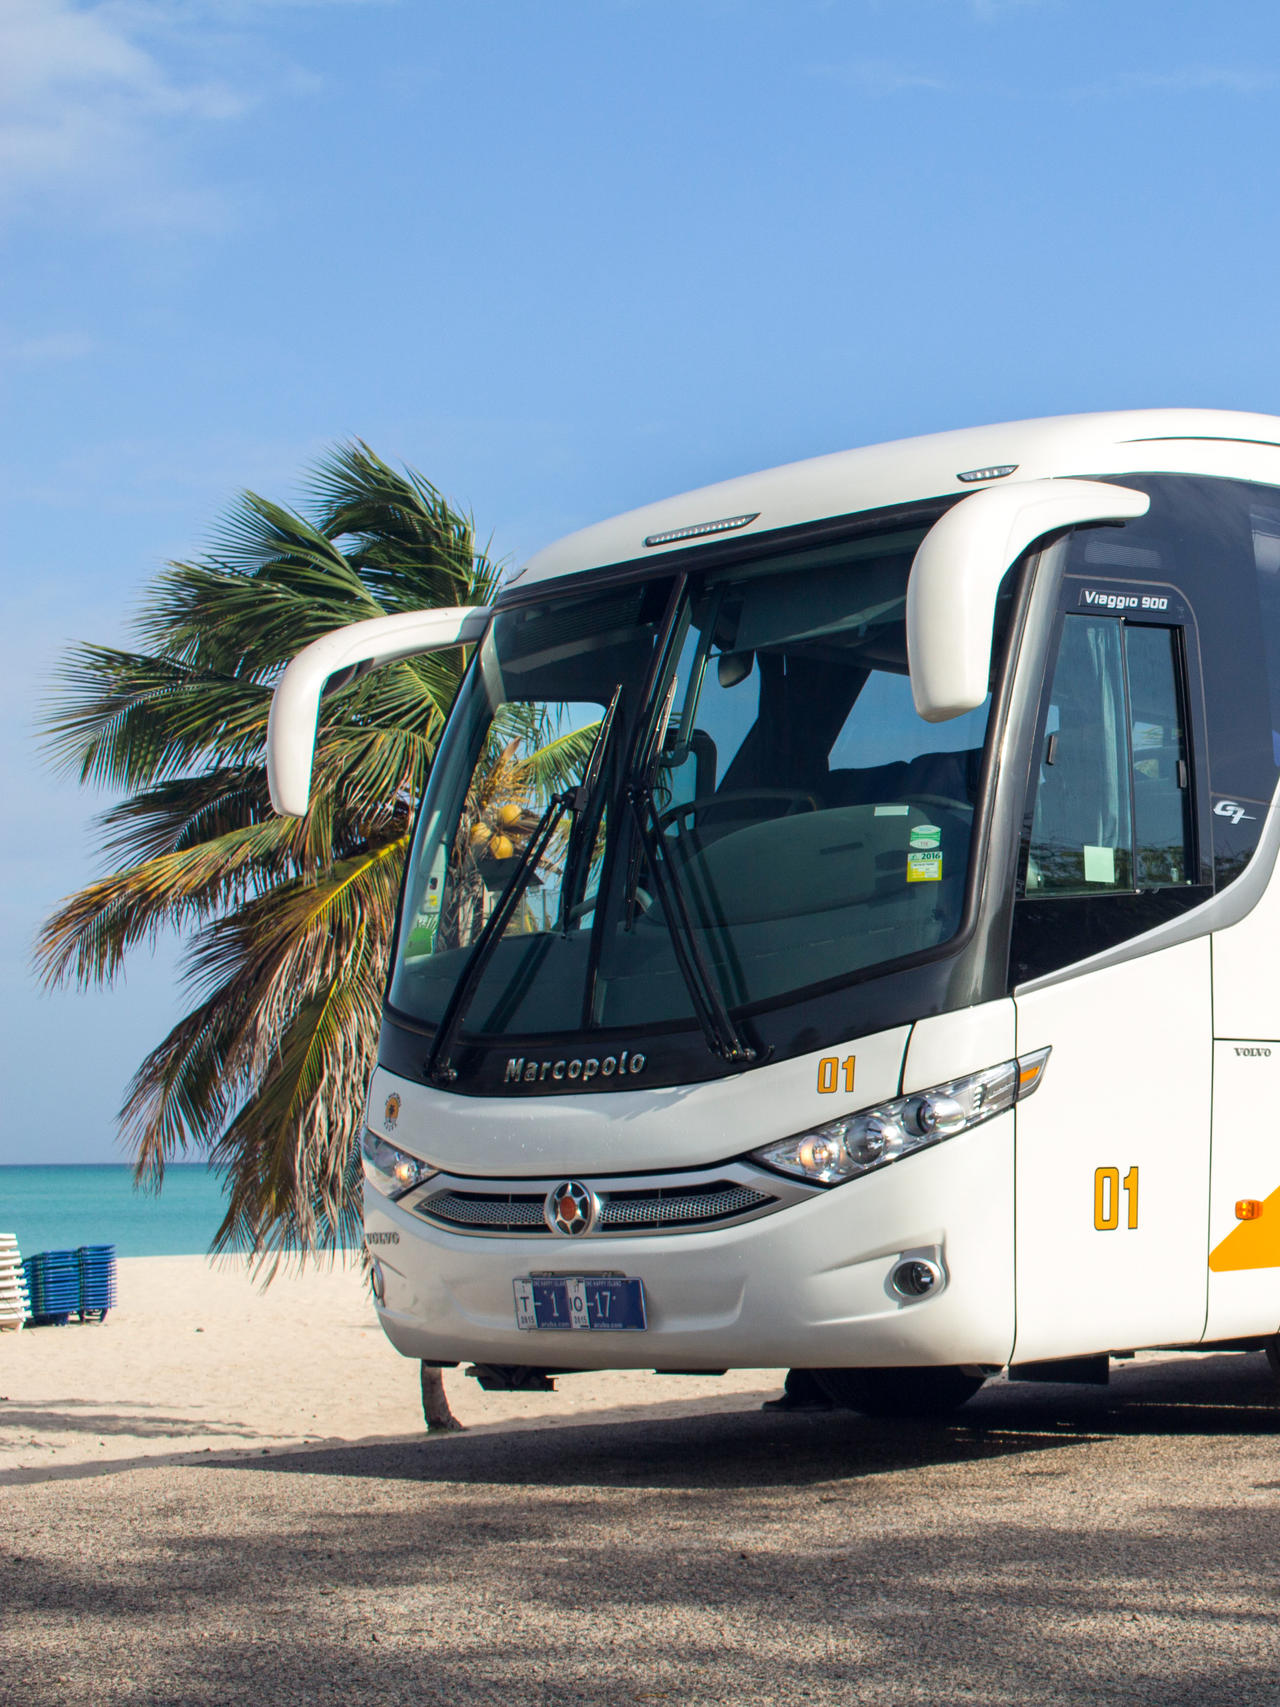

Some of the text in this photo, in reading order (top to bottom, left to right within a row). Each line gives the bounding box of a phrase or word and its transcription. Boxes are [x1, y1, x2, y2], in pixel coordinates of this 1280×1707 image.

[1085, 590, 1168, 610] Viaggio 900
[921, 851, 941, 860] 2016
[1233, 1047, 1272, 1058] VOLVO
[504, 1050, 647, 1083] Marcopolo
[816, 1055, 857, 1094] 01
[1094, 1165, 1139, 1231] 01
